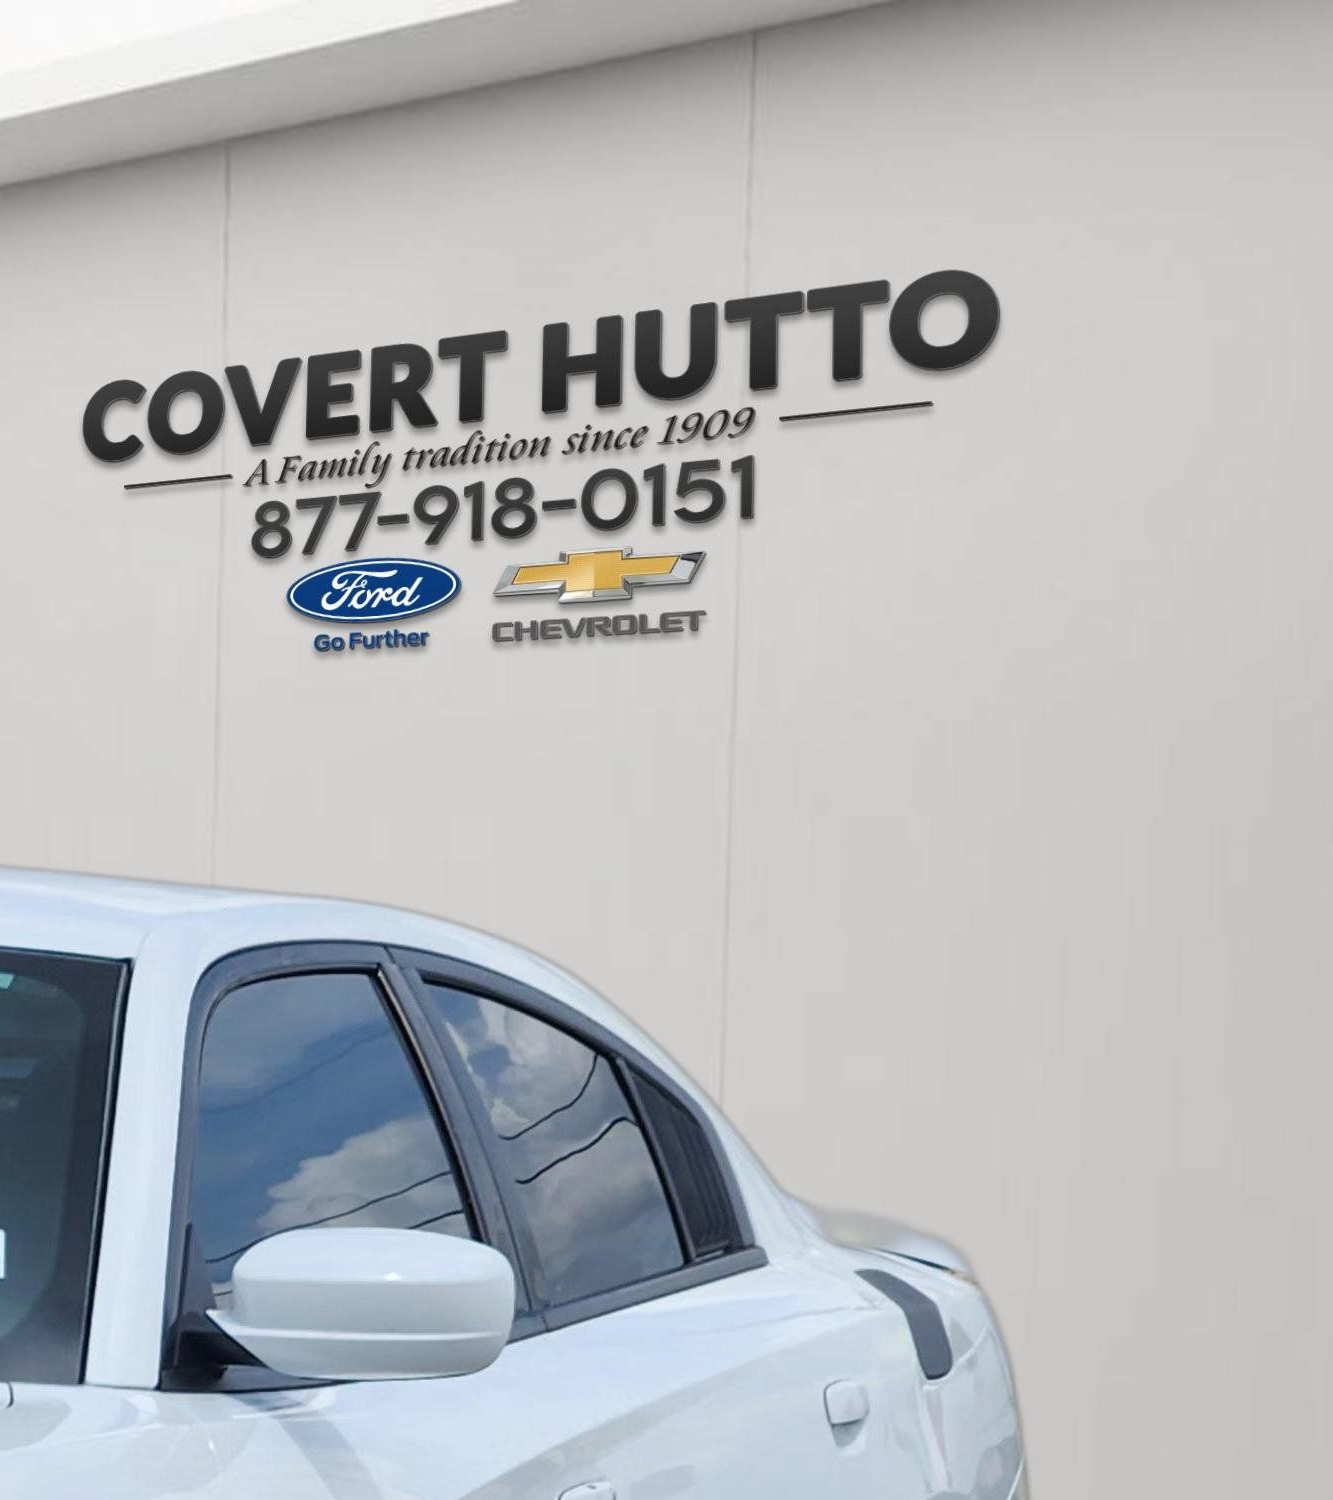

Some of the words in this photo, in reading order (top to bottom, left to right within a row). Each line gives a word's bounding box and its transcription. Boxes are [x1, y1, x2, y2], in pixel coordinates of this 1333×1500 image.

[82, 329, 509, 464] COVERT
[541, 269, 1001, 416] HUTTO
[242, 458, 271, 488] A
[275, 440, 392, 489] Family
[402, 429, 551, 472] tradition
[561, 424, 650, 458] since
[657, 406, 756, 446] 1909
[251, 455, 755, 560] 877-918-0151
[321, 569, 422, 609] Ford
[313, 634, 346, 653] Go
[348, 628, 431, 651] Further
[491, 609, 708, 643] CHEVROLET
